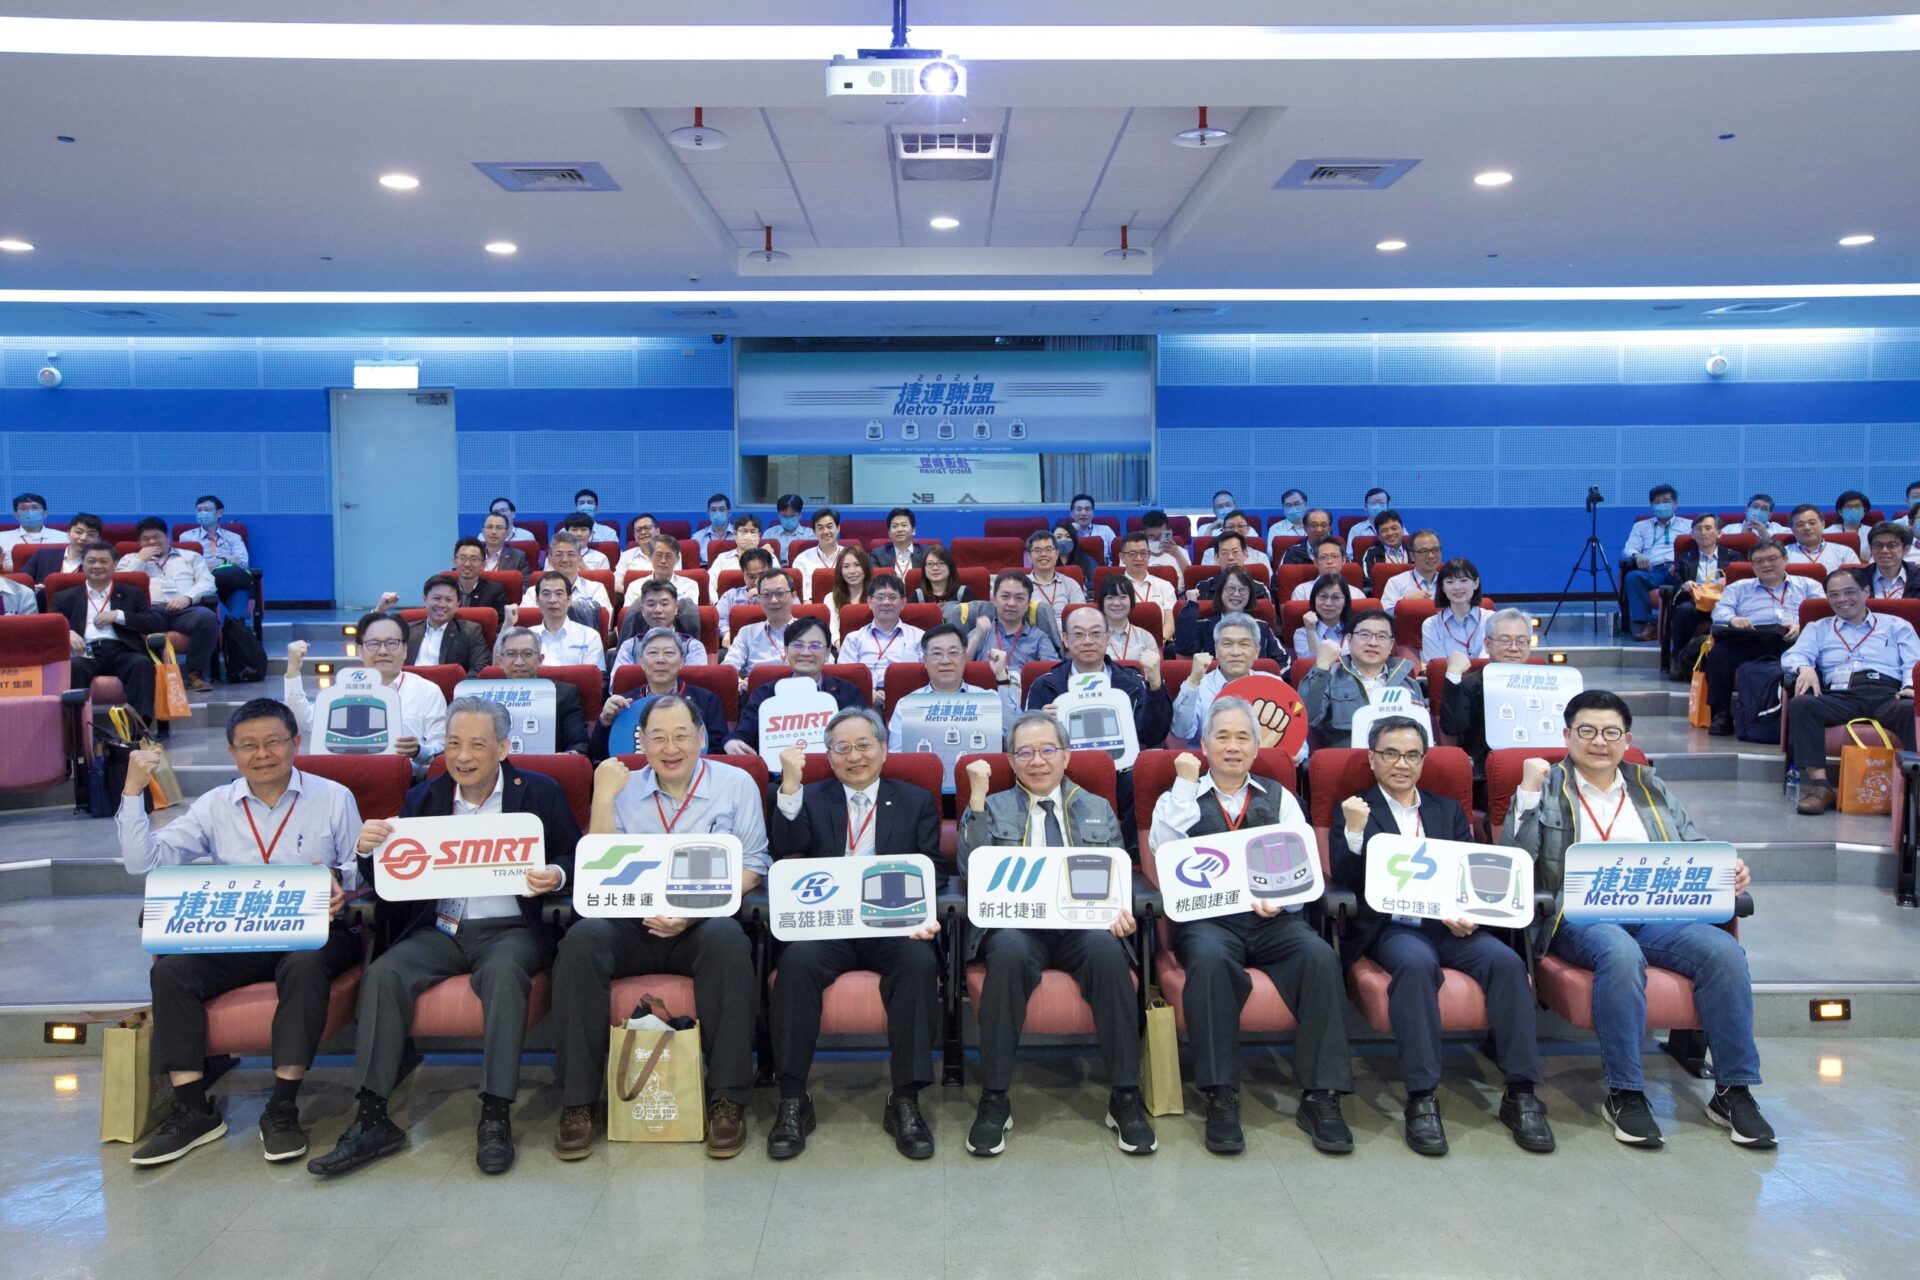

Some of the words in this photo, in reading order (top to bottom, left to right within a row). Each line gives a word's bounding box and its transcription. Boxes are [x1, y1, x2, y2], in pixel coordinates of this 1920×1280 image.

[918, 374, 979, 382] 2024
[898, 382, 995, 404] 捷運聯盟
[893, 402, 938, 415] Metro
[942, 402, 995, 415] Taiwan
[765, 711, 834, 733] SMRT
[925, 714, 949, 722] Metro
[950, 714, 978, 722] Taiwan
[765, 730, 823, 741] CORPORATI
[433, 837, 539, 865] SMRT
[1616, 856, 1694, 866] 2024
[492, 868, 534, 877] TRAIN
[1590, 866, 1713, 893] 捷運聯盟
[202, 880, 286, 890] 2024
[171, 890, 306, 920] 捷運聯盟
[587, 892, 654, 907] 台北捷運
[1175, 889, 1241, 914] 桃園捷運
[1382, 896, 1441, 916] 台中捷運
[1583, 891, 1640, 906] Metro
[1646, 891, 1713, 906] Taiwan
[979, 901, 1047, 919] 新北捷運
[165, 918, 227, 934] Metro
[234, 917, 305, 933] Taiwan
[779, 908, 854, 930] 高雄捷運
